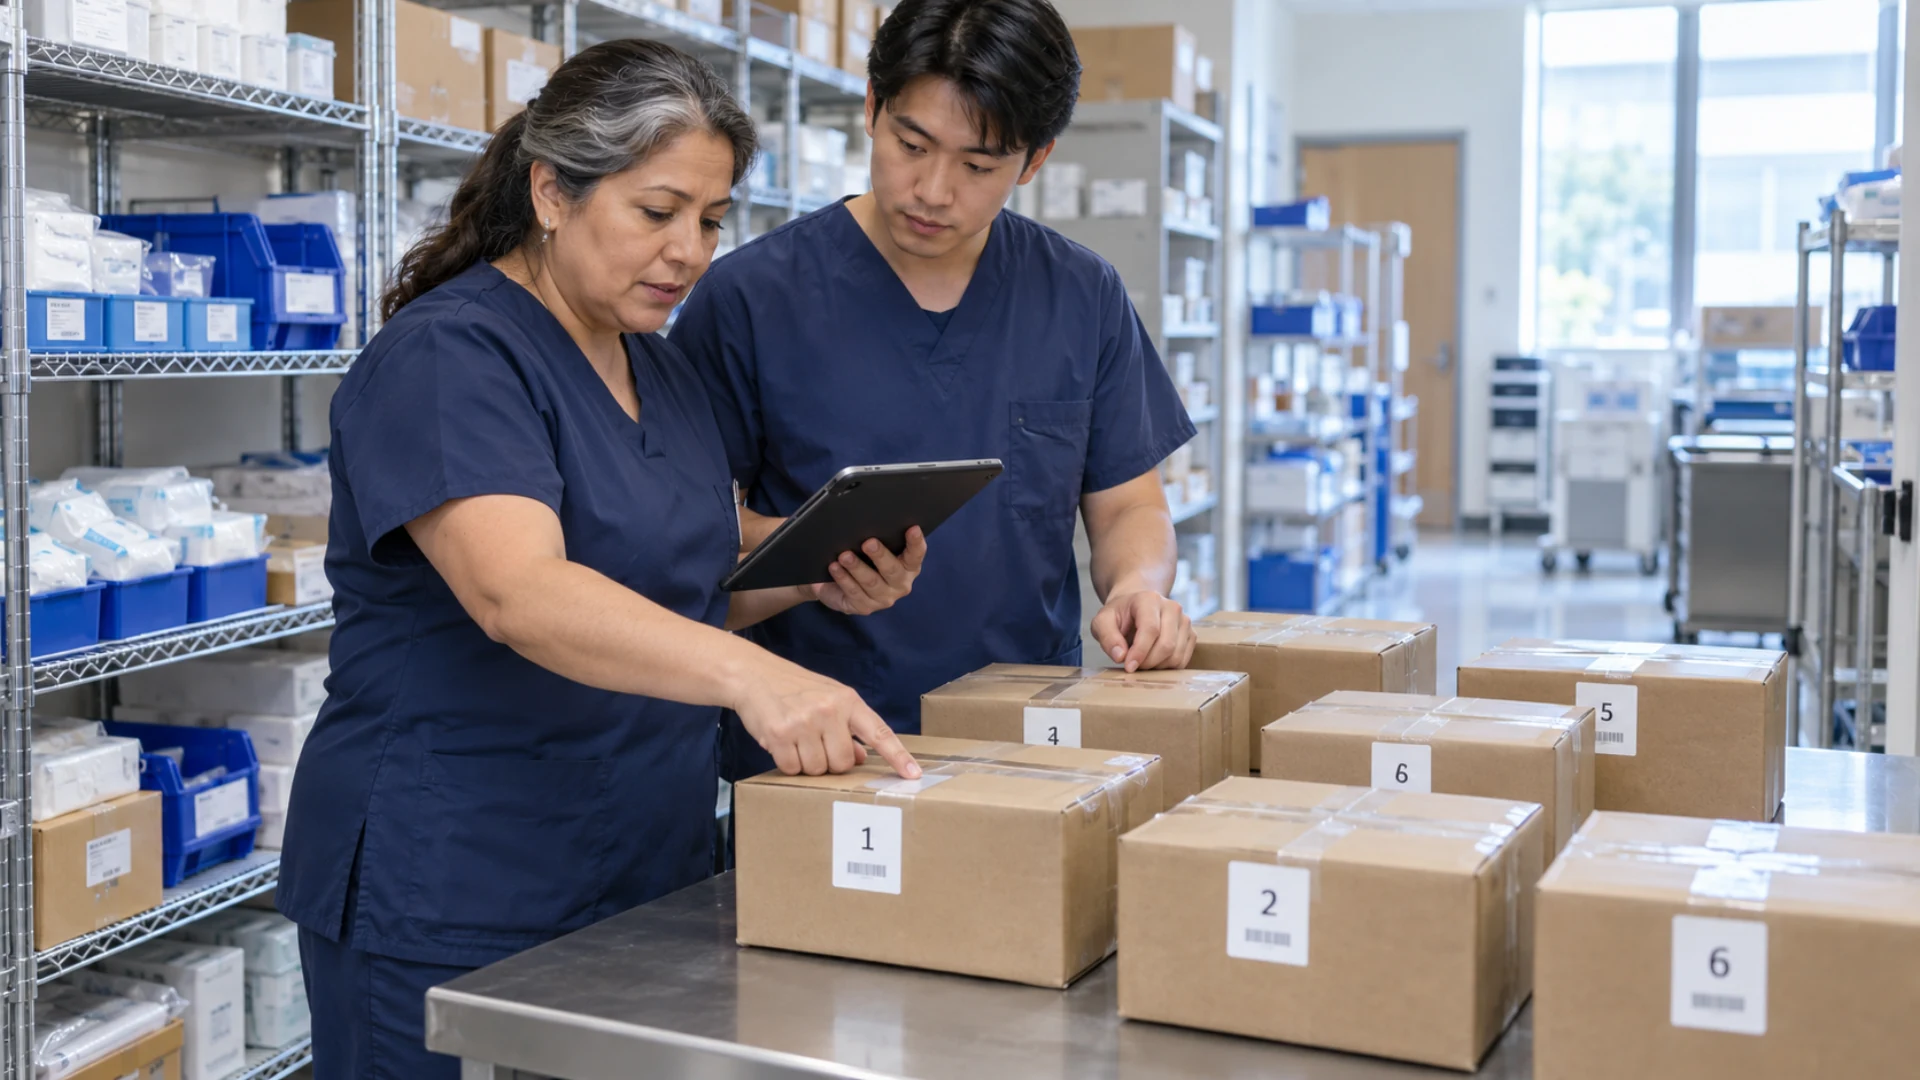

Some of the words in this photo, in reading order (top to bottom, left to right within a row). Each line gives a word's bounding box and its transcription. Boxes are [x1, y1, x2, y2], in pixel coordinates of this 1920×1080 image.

[1601, 702, 1613, 722] 5
[1395, 763, 1408, 784] 6
[861, 827, 874, 851] 1
[1260, 889, 1278, 916] 2
[1709, 948, 1730, 977] 6
